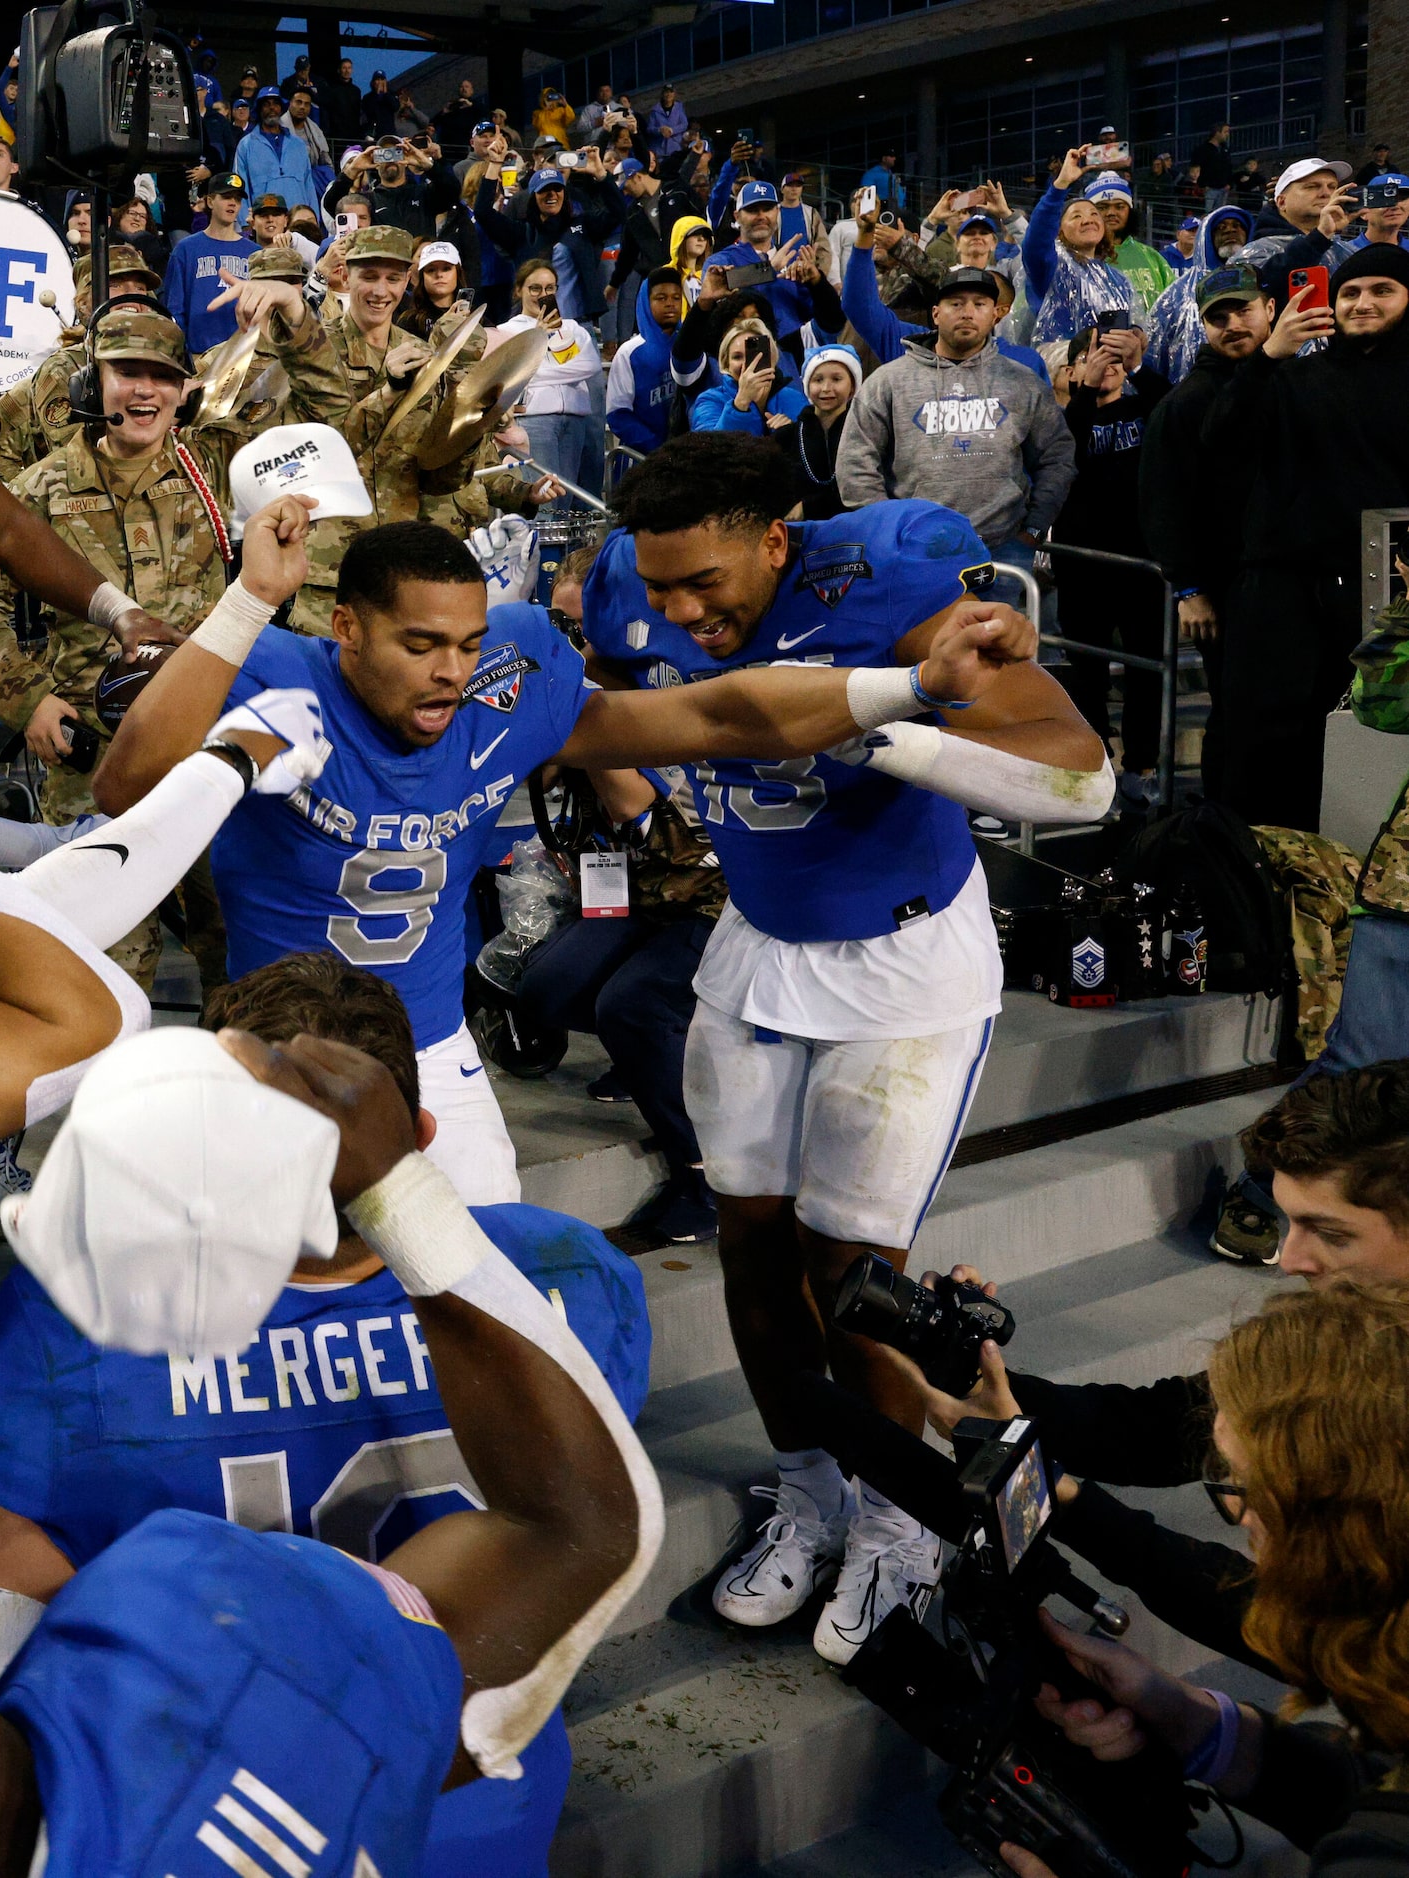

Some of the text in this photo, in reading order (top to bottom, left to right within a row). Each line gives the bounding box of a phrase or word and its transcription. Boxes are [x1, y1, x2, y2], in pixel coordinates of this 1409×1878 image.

[753, 183, 768, 196] AF
[1101, 191, 1114, 200] AF
[196, 255, 249, 280] AIR FORC
[5, 366, 35, 386] CORPS
[924, 408, 998, 435] BOWL
[953, 436, 972, 453] AF
[253, 440, 319, 478] CHAMPS
[64, 498, 99, 513] HARVEY
[802, 563, 865, 584] ARMED FORCES
[461, 674, 492, 699] ARMED
[492, 659, 529, 681] FORCES
[484, 679, 511, 696] BOWL
[286, 783, 358, 844] AIR
[366, 774, 515, 852] FORCE
[326, 847, 448, 966] 9
[906, 905, 917, 916] L
[906, 1685, 916, 1696] G
